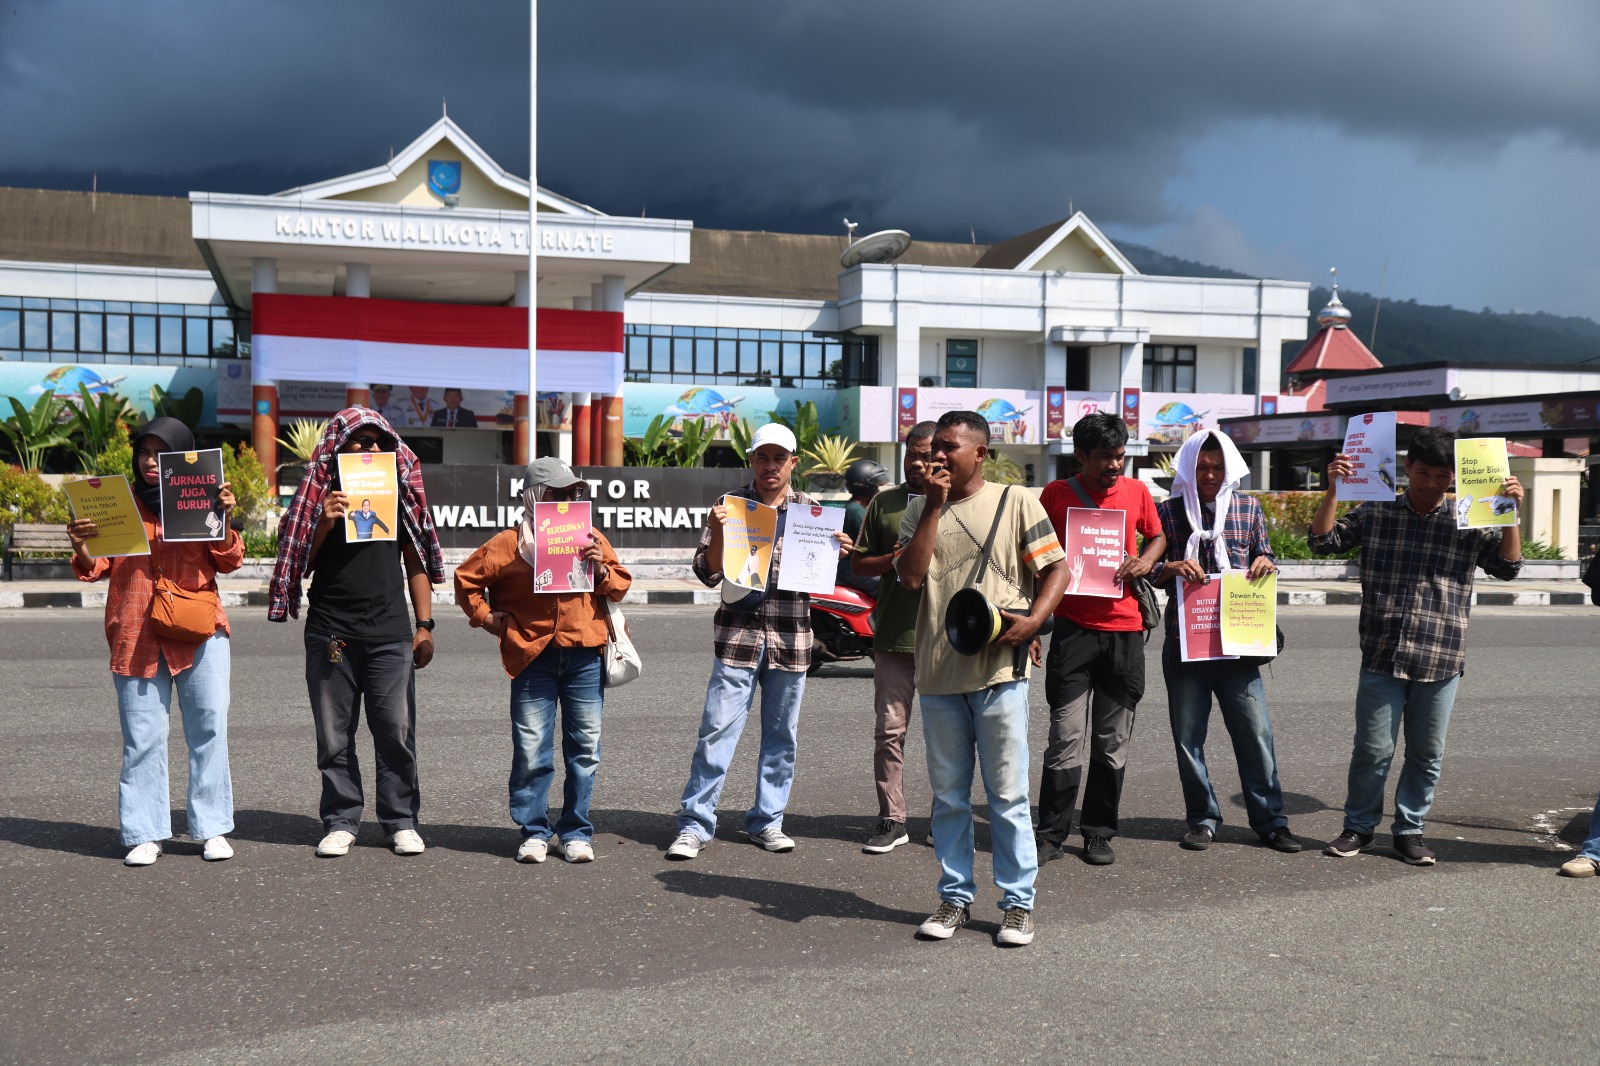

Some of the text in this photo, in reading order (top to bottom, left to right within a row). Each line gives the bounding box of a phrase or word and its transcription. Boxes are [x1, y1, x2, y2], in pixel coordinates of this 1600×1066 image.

[276, 213, 614, 252] KANTOR WALIKOTA TRNATE
[1462, 457, 1478, 466] Stop
[1462, 467, 1485, 475] Blokar
[169, 473, 216, 486] JURNALIS
[180, 488, 207, 498] JUGA
[510, 478, 650, 499] KTOR
[177, 499, 211, 510] BURUH
[597, 506, 712, 528] TERNAT
[1081, 526, 1119, 536] fakta harus
[547, 536, 574, 545] SEBELUM
[1082, 547, 1120, 558] hak jangan
[1098, 559, 1120, 570] hilang
[1230, 591, 1267, 600] Dewan Pers,
